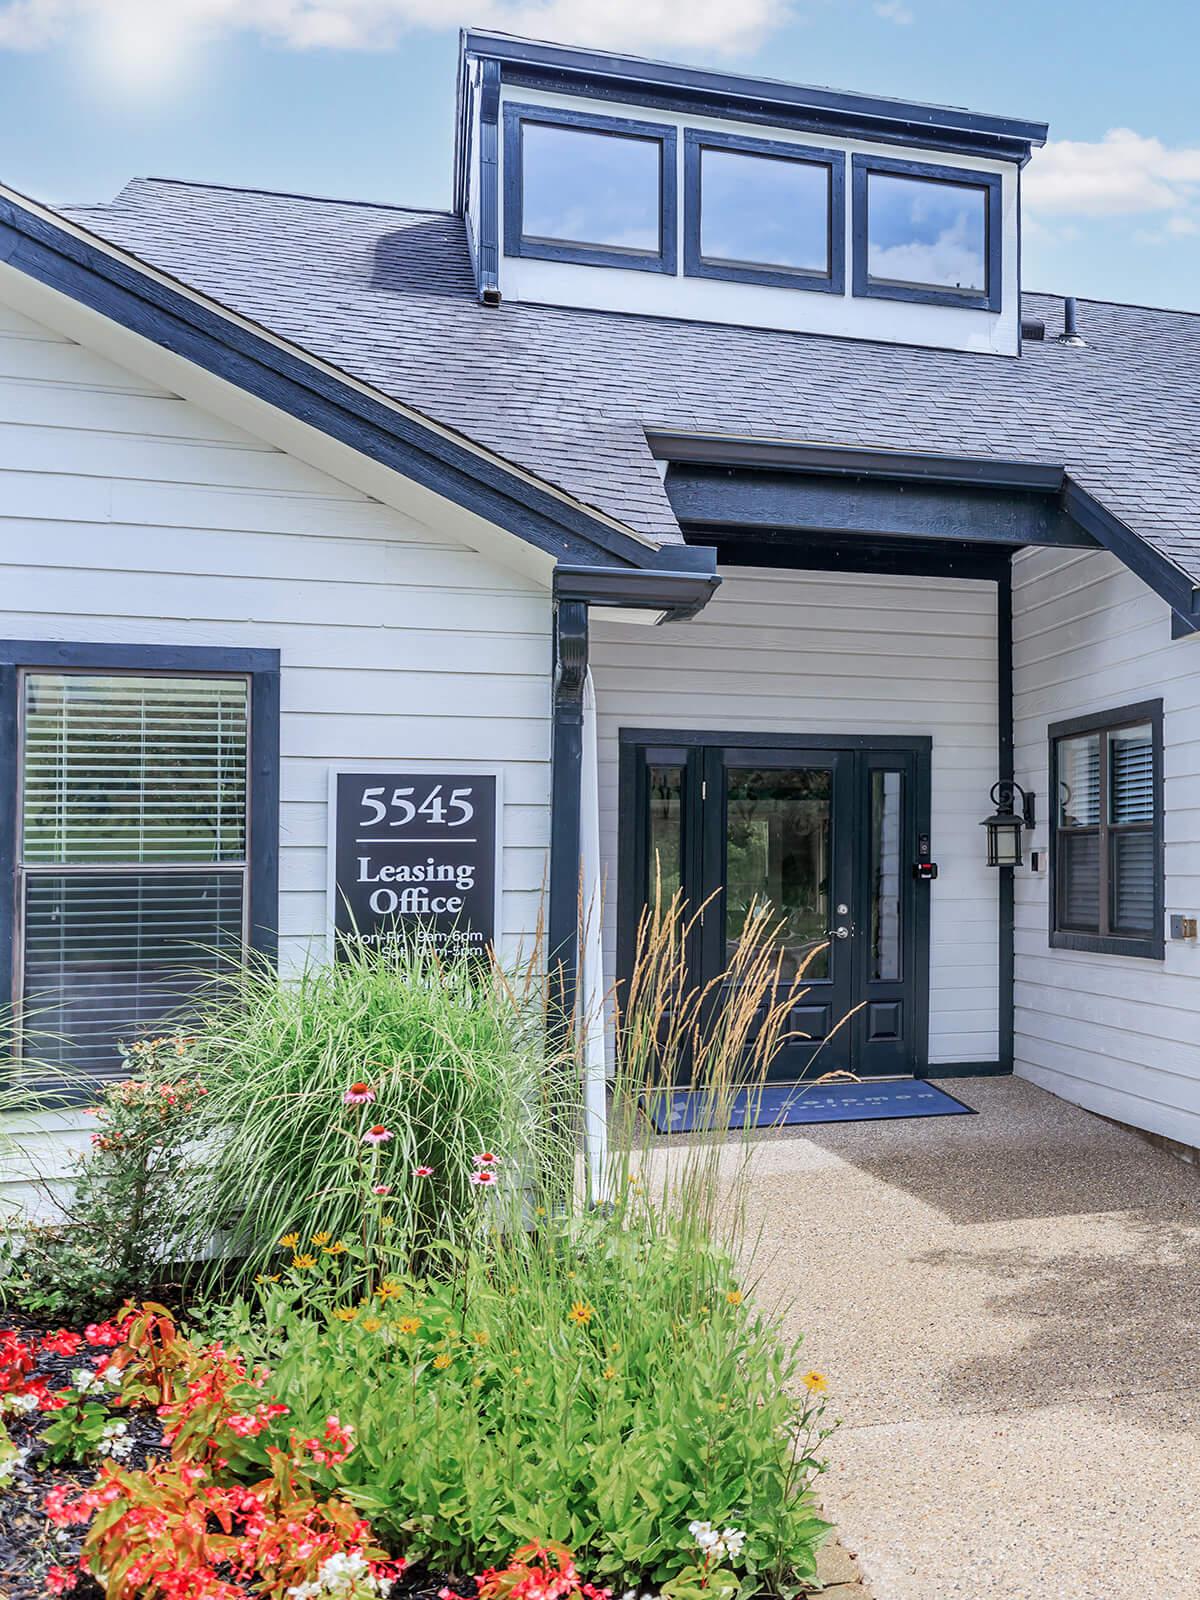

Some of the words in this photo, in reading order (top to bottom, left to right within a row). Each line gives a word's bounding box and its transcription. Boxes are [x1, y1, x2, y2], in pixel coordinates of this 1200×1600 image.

[359, 784, 474, 827] 5545
[356, 856, 476, 890] Leasing
[369, 886, 462, 915] Office
[346, 931, 406, 945] Mon-Fr
